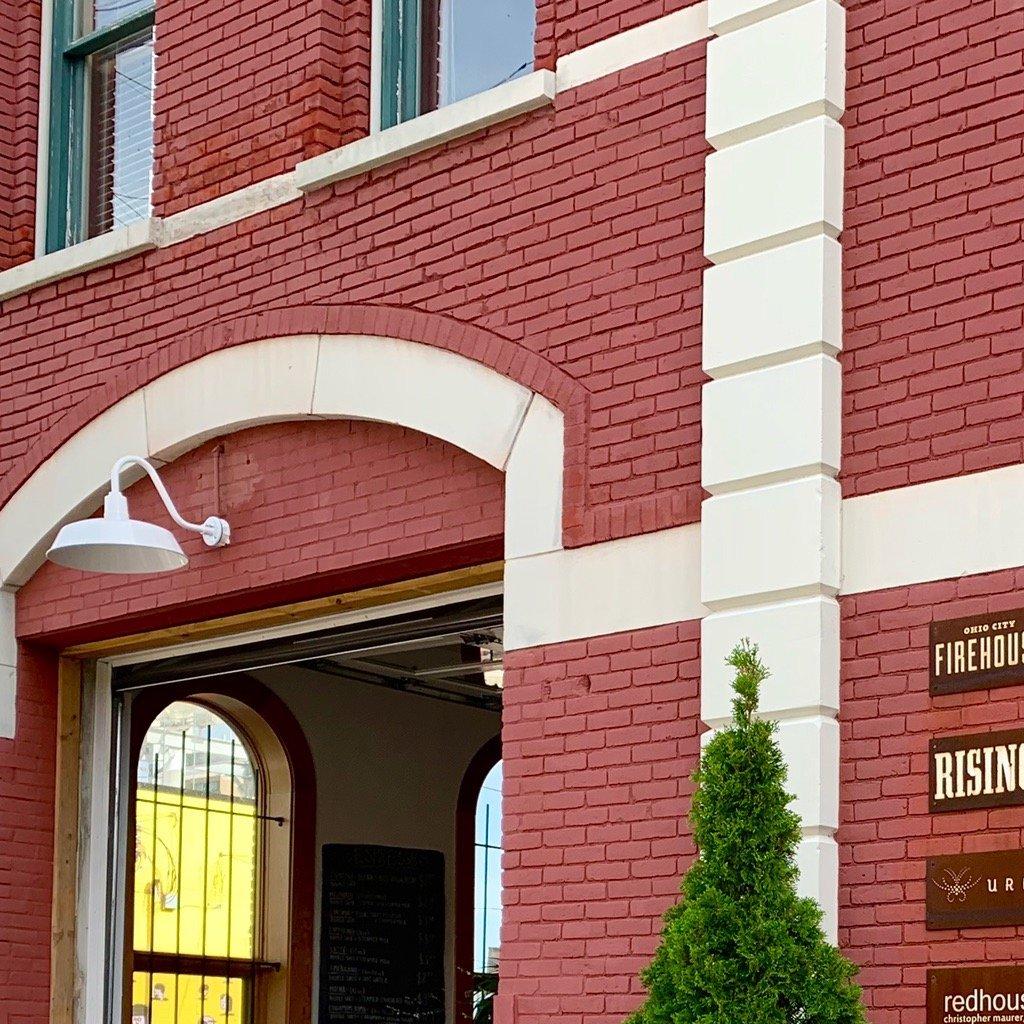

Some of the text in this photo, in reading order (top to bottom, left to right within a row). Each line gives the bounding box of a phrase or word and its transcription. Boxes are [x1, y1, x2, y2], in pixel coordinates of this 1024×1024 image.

[964, 620, 1016, 635] OHIO CITY
[944, 1013, 991, 1024] christopher
